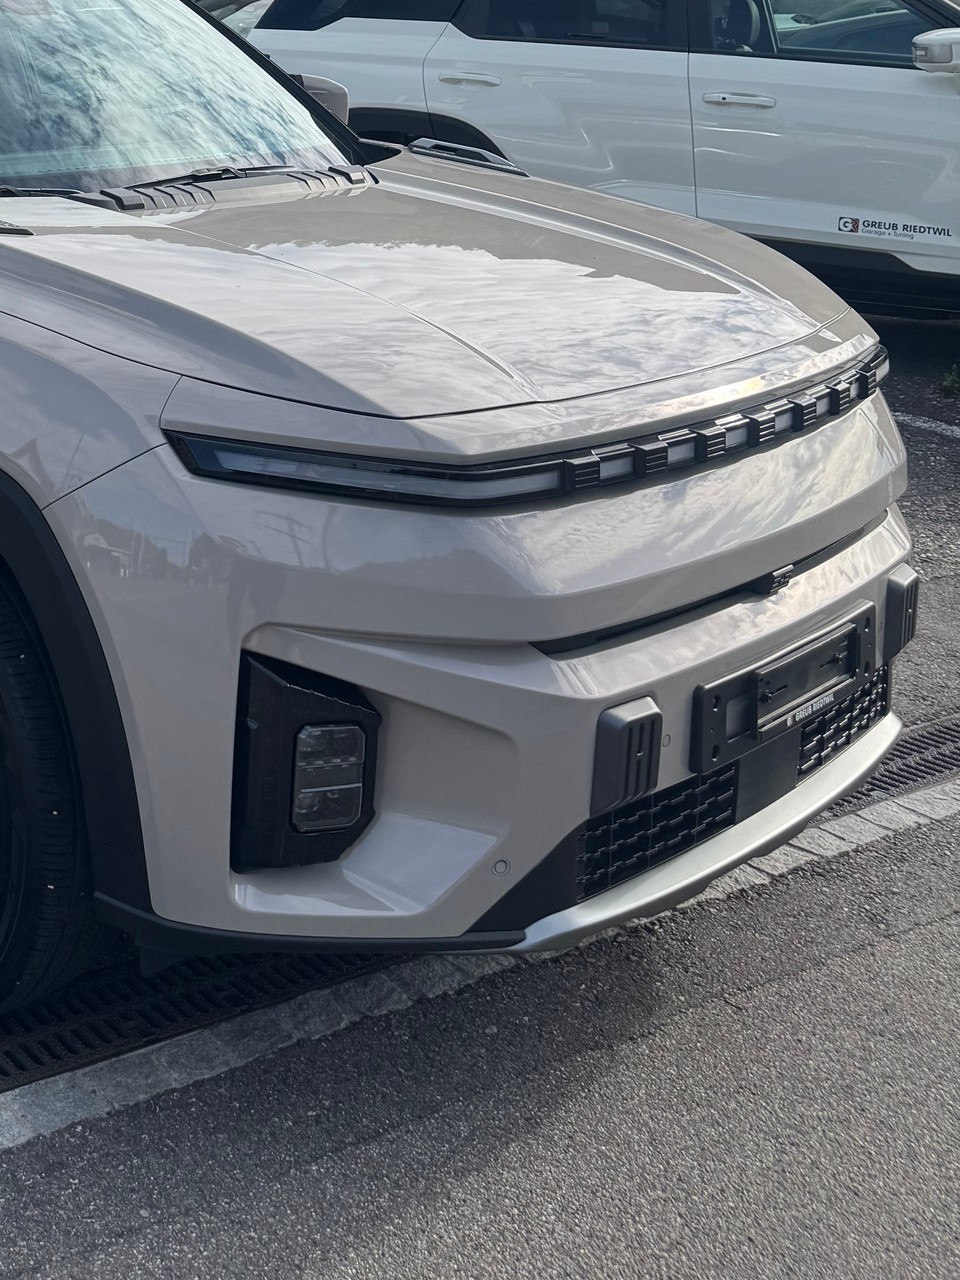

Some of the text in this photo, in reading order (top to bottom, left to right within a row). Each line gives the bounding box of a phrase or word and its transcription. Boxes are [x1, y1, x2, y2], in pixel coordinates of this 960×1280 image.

[861, 228, 886, 237] Garage
[893, 229, 915, 240] Tuning
[862, 219, 952, 237] GREUB RIEDTWIL
